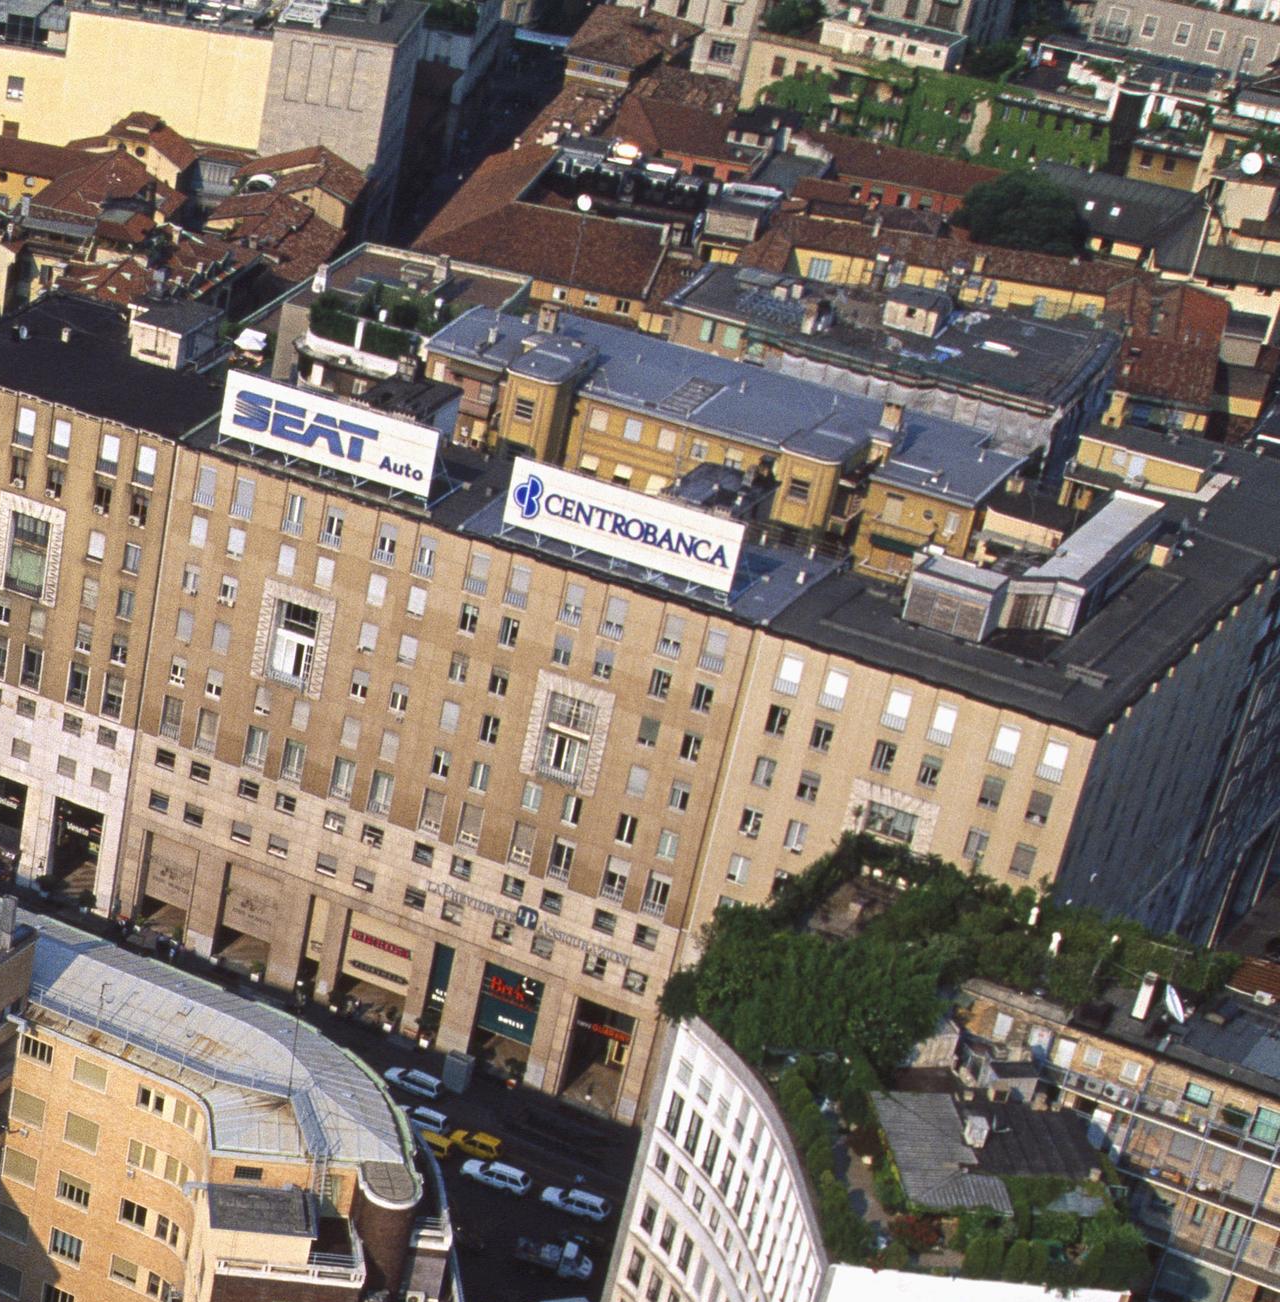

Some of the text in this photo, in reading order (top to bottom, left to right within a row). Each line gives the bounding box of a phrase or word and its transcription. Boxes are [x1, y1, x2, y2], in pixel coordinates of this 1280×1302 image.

[233, 390, 379, 462] SEAT
[379, 456, 424, 481] Auto
[545, 493, 729, 569] CENTROBANCA
